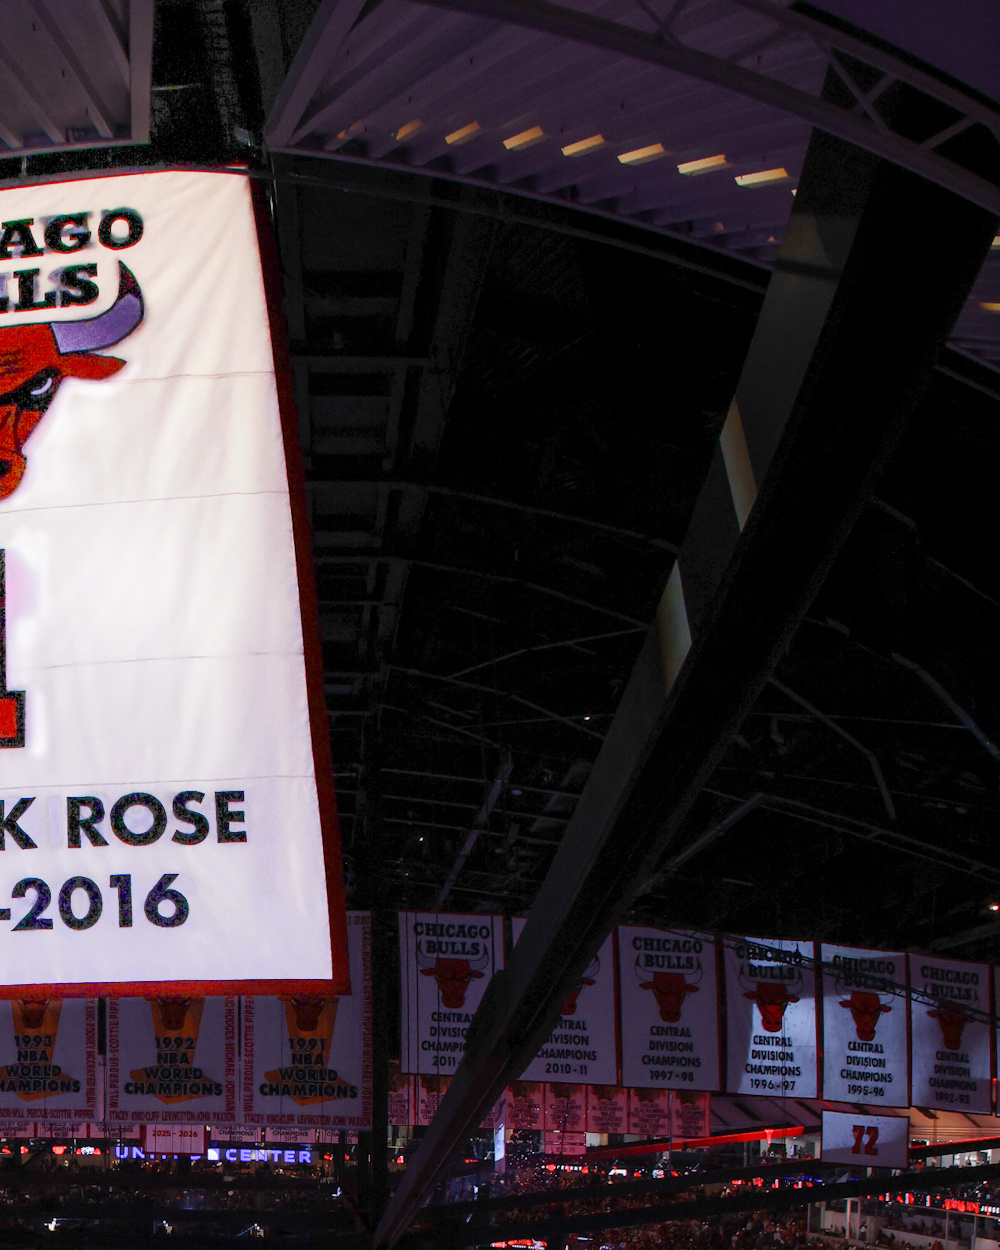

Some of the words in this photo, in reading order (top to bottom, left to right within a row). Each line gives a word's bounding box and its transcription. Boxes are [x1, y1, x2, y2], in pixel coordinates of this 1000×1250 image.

[66, 790, 248, 849] ROSE
[413, 922, 490, 940] CHICAGO
[426, 940, 480, 956] BULLS
[632, 936, 703, 954] CHICAGO
[644, 954, 694, 970] BULLS
[832, 954, 896, 975] CHICAGO
[748, 963, 796, 980] BULLS
[921, 965, 979, 985] CHICAGO
[932, 983, 972, 1000] BULLS
[431, 1011, 474, 1023] CENTRA
[650, 1025, 692, 1038] CENTRAL
[14, 1035, 53, 1047] 1993
[154, 1036, 195, 1050] 1992
[289, 1037, 326, 1051] 1991
[550, 1034, 589, 1046] IVISION
[649, 1040, 693, 1052] DIVISION
[752, 1035, 792, 1047] CENTRAL
[848, 1041, 884, 1054] CENTRAL
[17, 1049, 49, 1062] NBA
[156, 1052, 190, 1065] NBA
[291, 1053, 325, 1066] NBA
[641, 1054, 701, 1067] CHAMPIONS
[751, 1049, 794, 1062] DIVISION
[846, 1055, 886, 1068] DIVISION
[935, 1050, 970, 1064] CENTRAL
[4, 1065, 61, 1078] WORLD
[144, 1067, 203, 1080] WORLD
[279, 1068, 338, 1082] WORLD
[745, 1064, 801, 1076] CHAMPIONS
[840, 1070, 892, 1083] CHAMPIONS
[934, 1065, 971, 1078] DIVISION
[124, 1082, 223, 1097] CHAMPIONS
[259, 1083, 358, 1099] CHAMPIONS
[929, 1077, 977, 1092] CHAMPIONS
[851, 1125, 879, 1156] 72
[225, 1147, 312, 1164] CENTER
